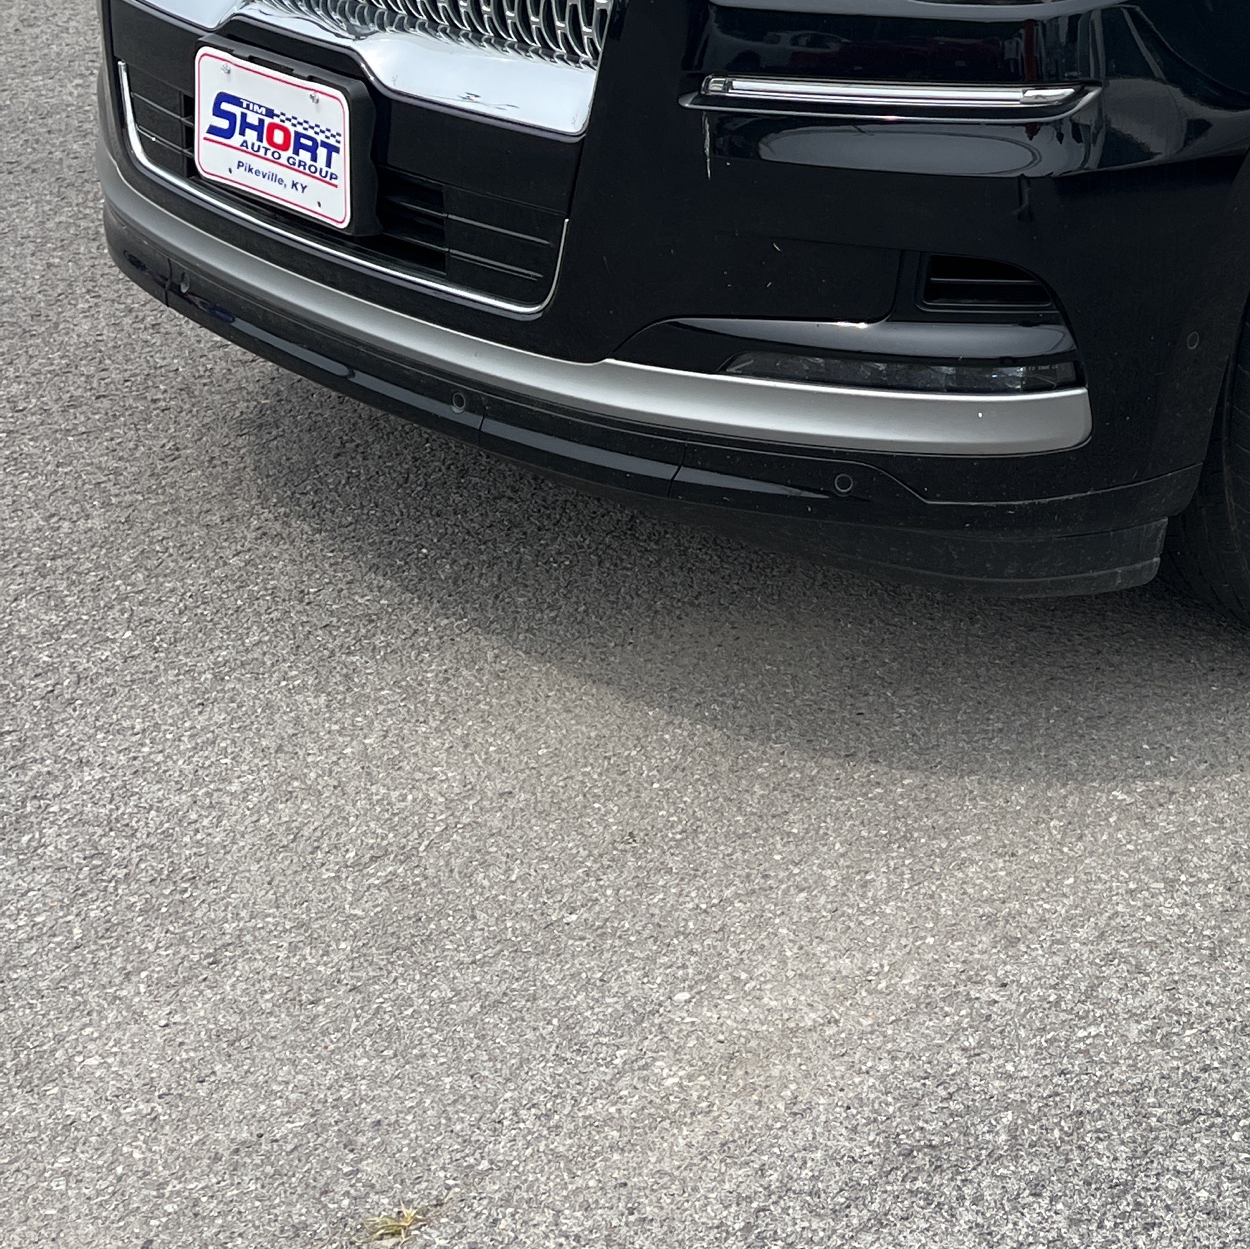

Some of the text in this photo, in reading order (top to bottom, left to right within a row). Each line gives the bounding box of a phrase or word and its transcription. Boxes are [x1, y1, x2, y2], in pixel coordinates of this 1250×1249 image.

[239, 99, 266, 116] TIM
[206, 92, 340, 169] SHORT
[236, 160, 308, 194] Pikeville, KY
[239, 139, 339, 182] AUTO GROUP
